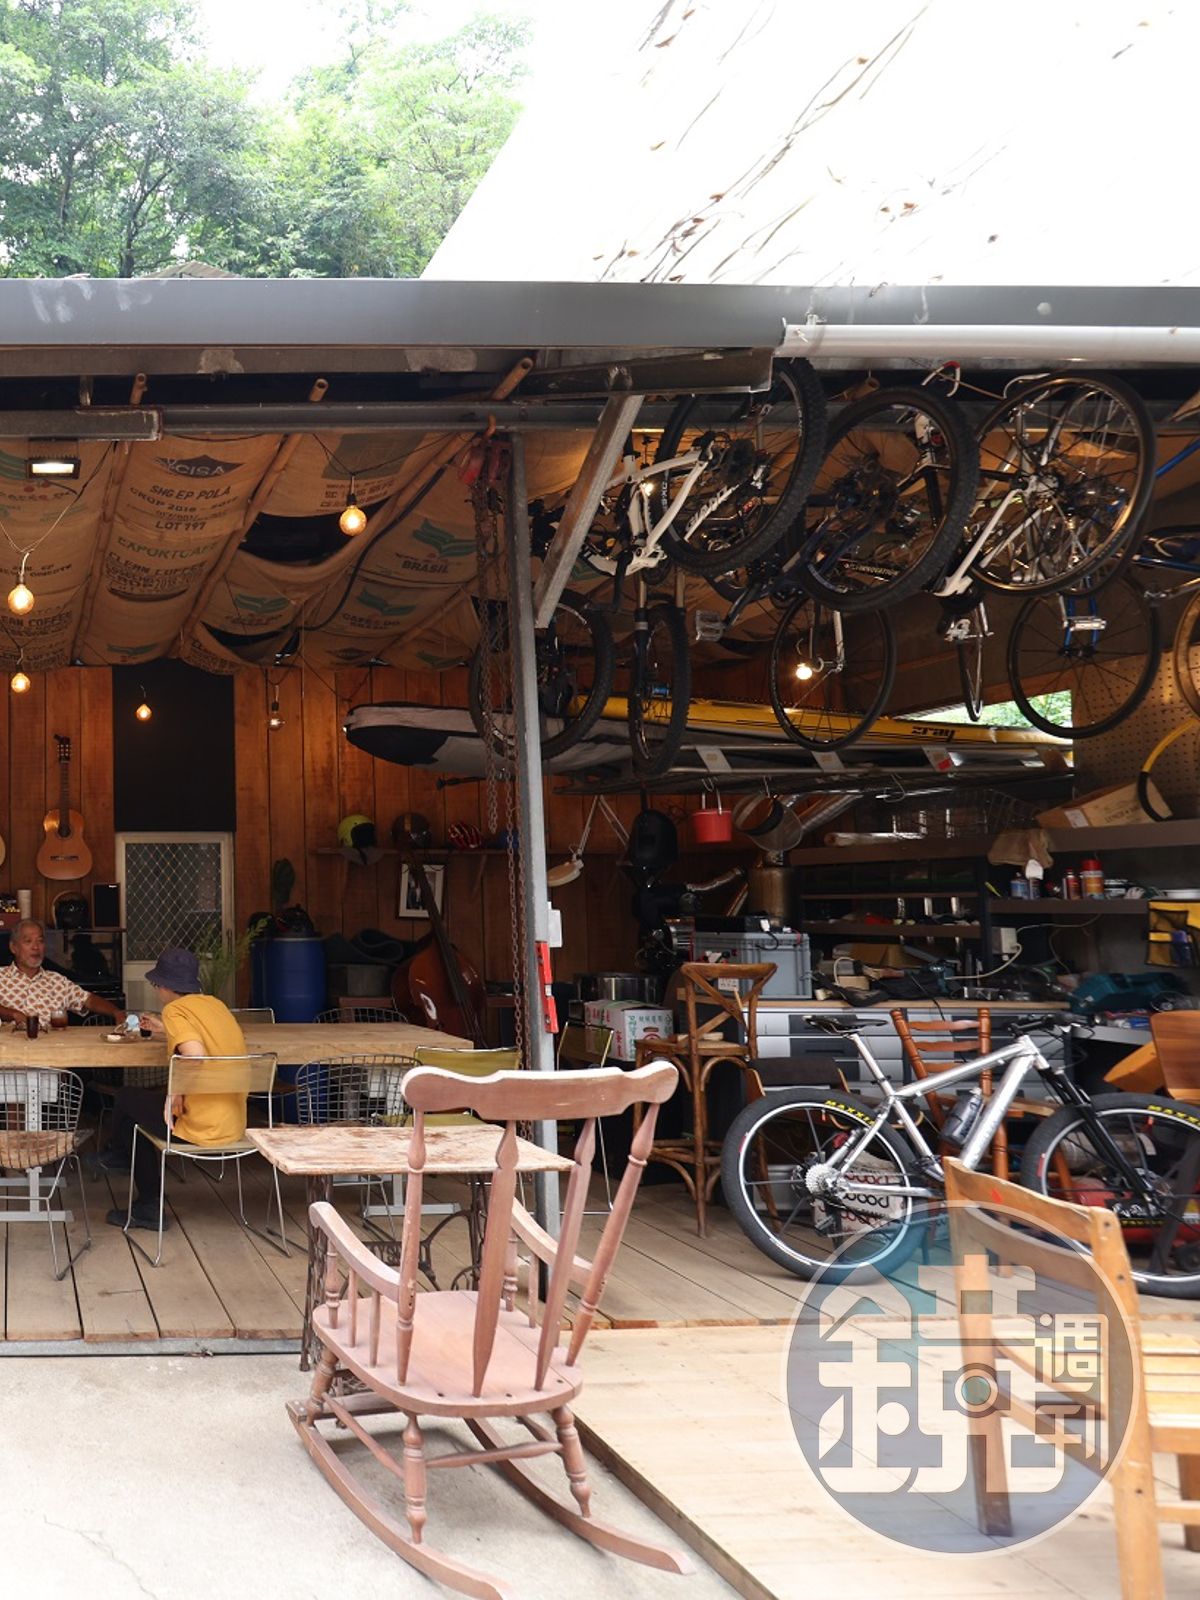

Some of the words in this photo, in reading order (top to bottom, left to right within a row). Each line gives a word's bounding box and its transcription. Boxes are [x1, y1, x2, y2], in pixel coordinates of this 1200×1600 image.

[150, 485, 173, 498] SHG
[177, 491, 195, 500] EP
[196, 486, 232, 501] POLA
[155, 522, 181, 531] LOT
[400, 560, 449, 575] BRASIL
